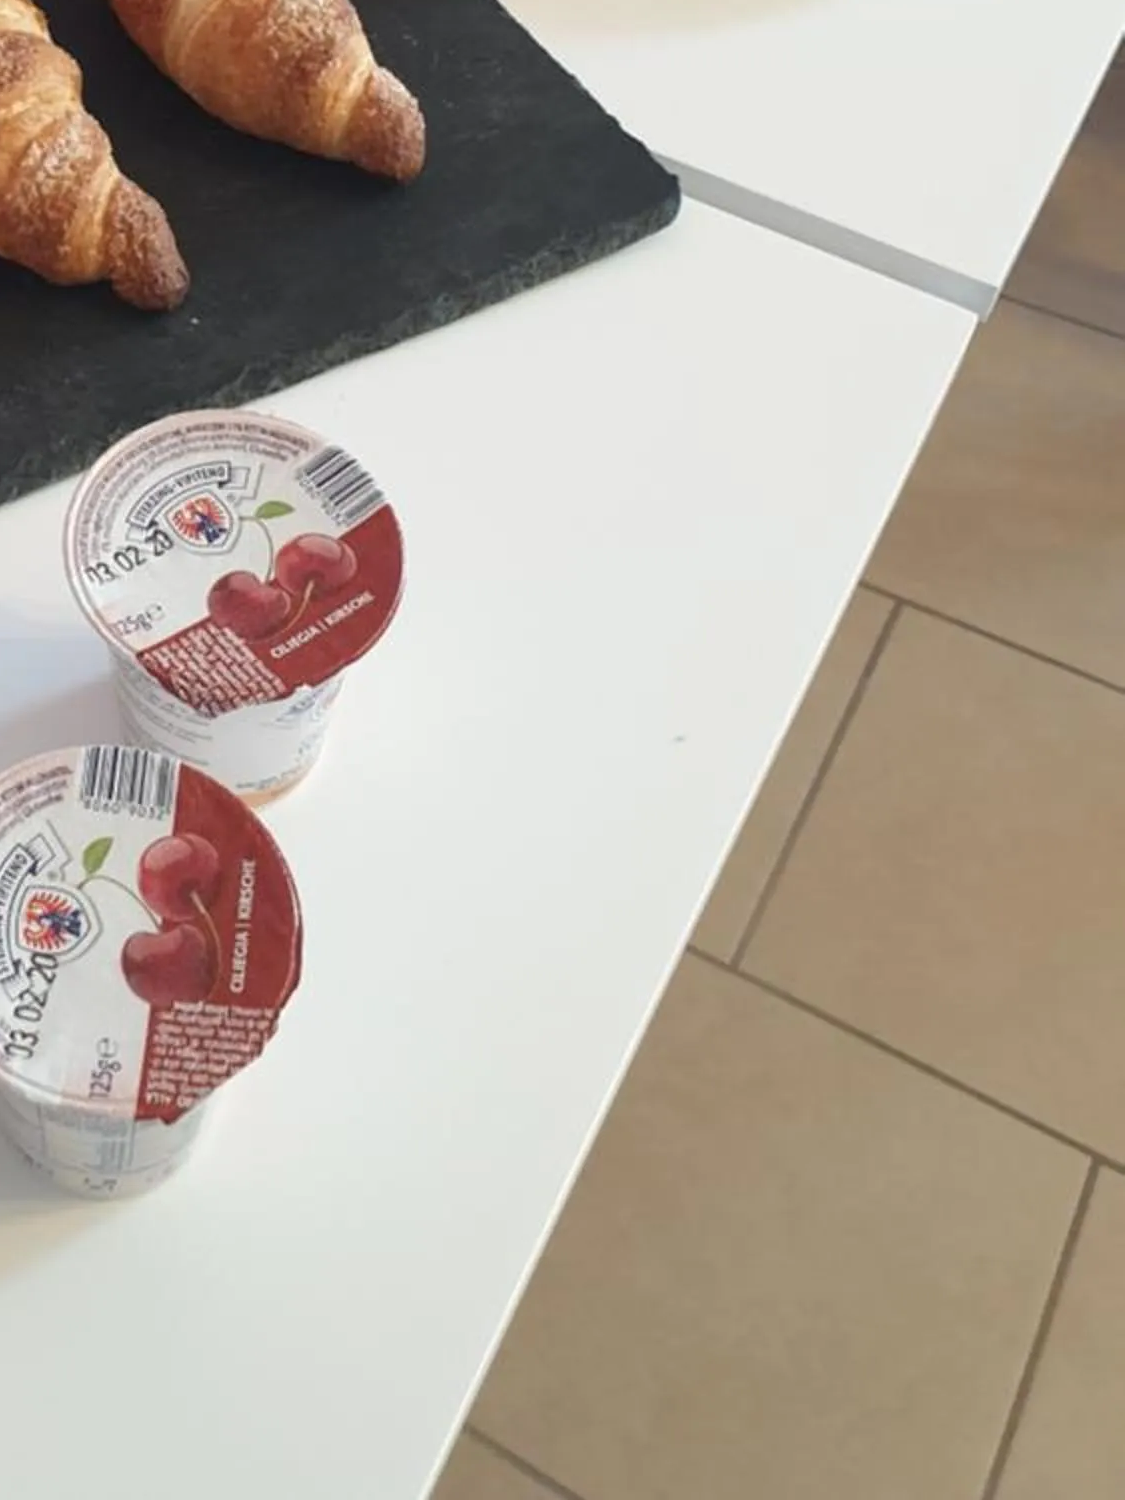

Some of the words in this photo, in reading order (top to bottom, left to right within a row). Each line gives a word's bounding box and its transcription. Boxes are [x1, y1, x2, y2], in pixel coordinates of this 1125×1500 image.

[121, 544, 148, 573] 02
[145, 528, 174, 557] 20
[29, 952, 58, 986] 20
[13, 984, 47, 1023] 02
